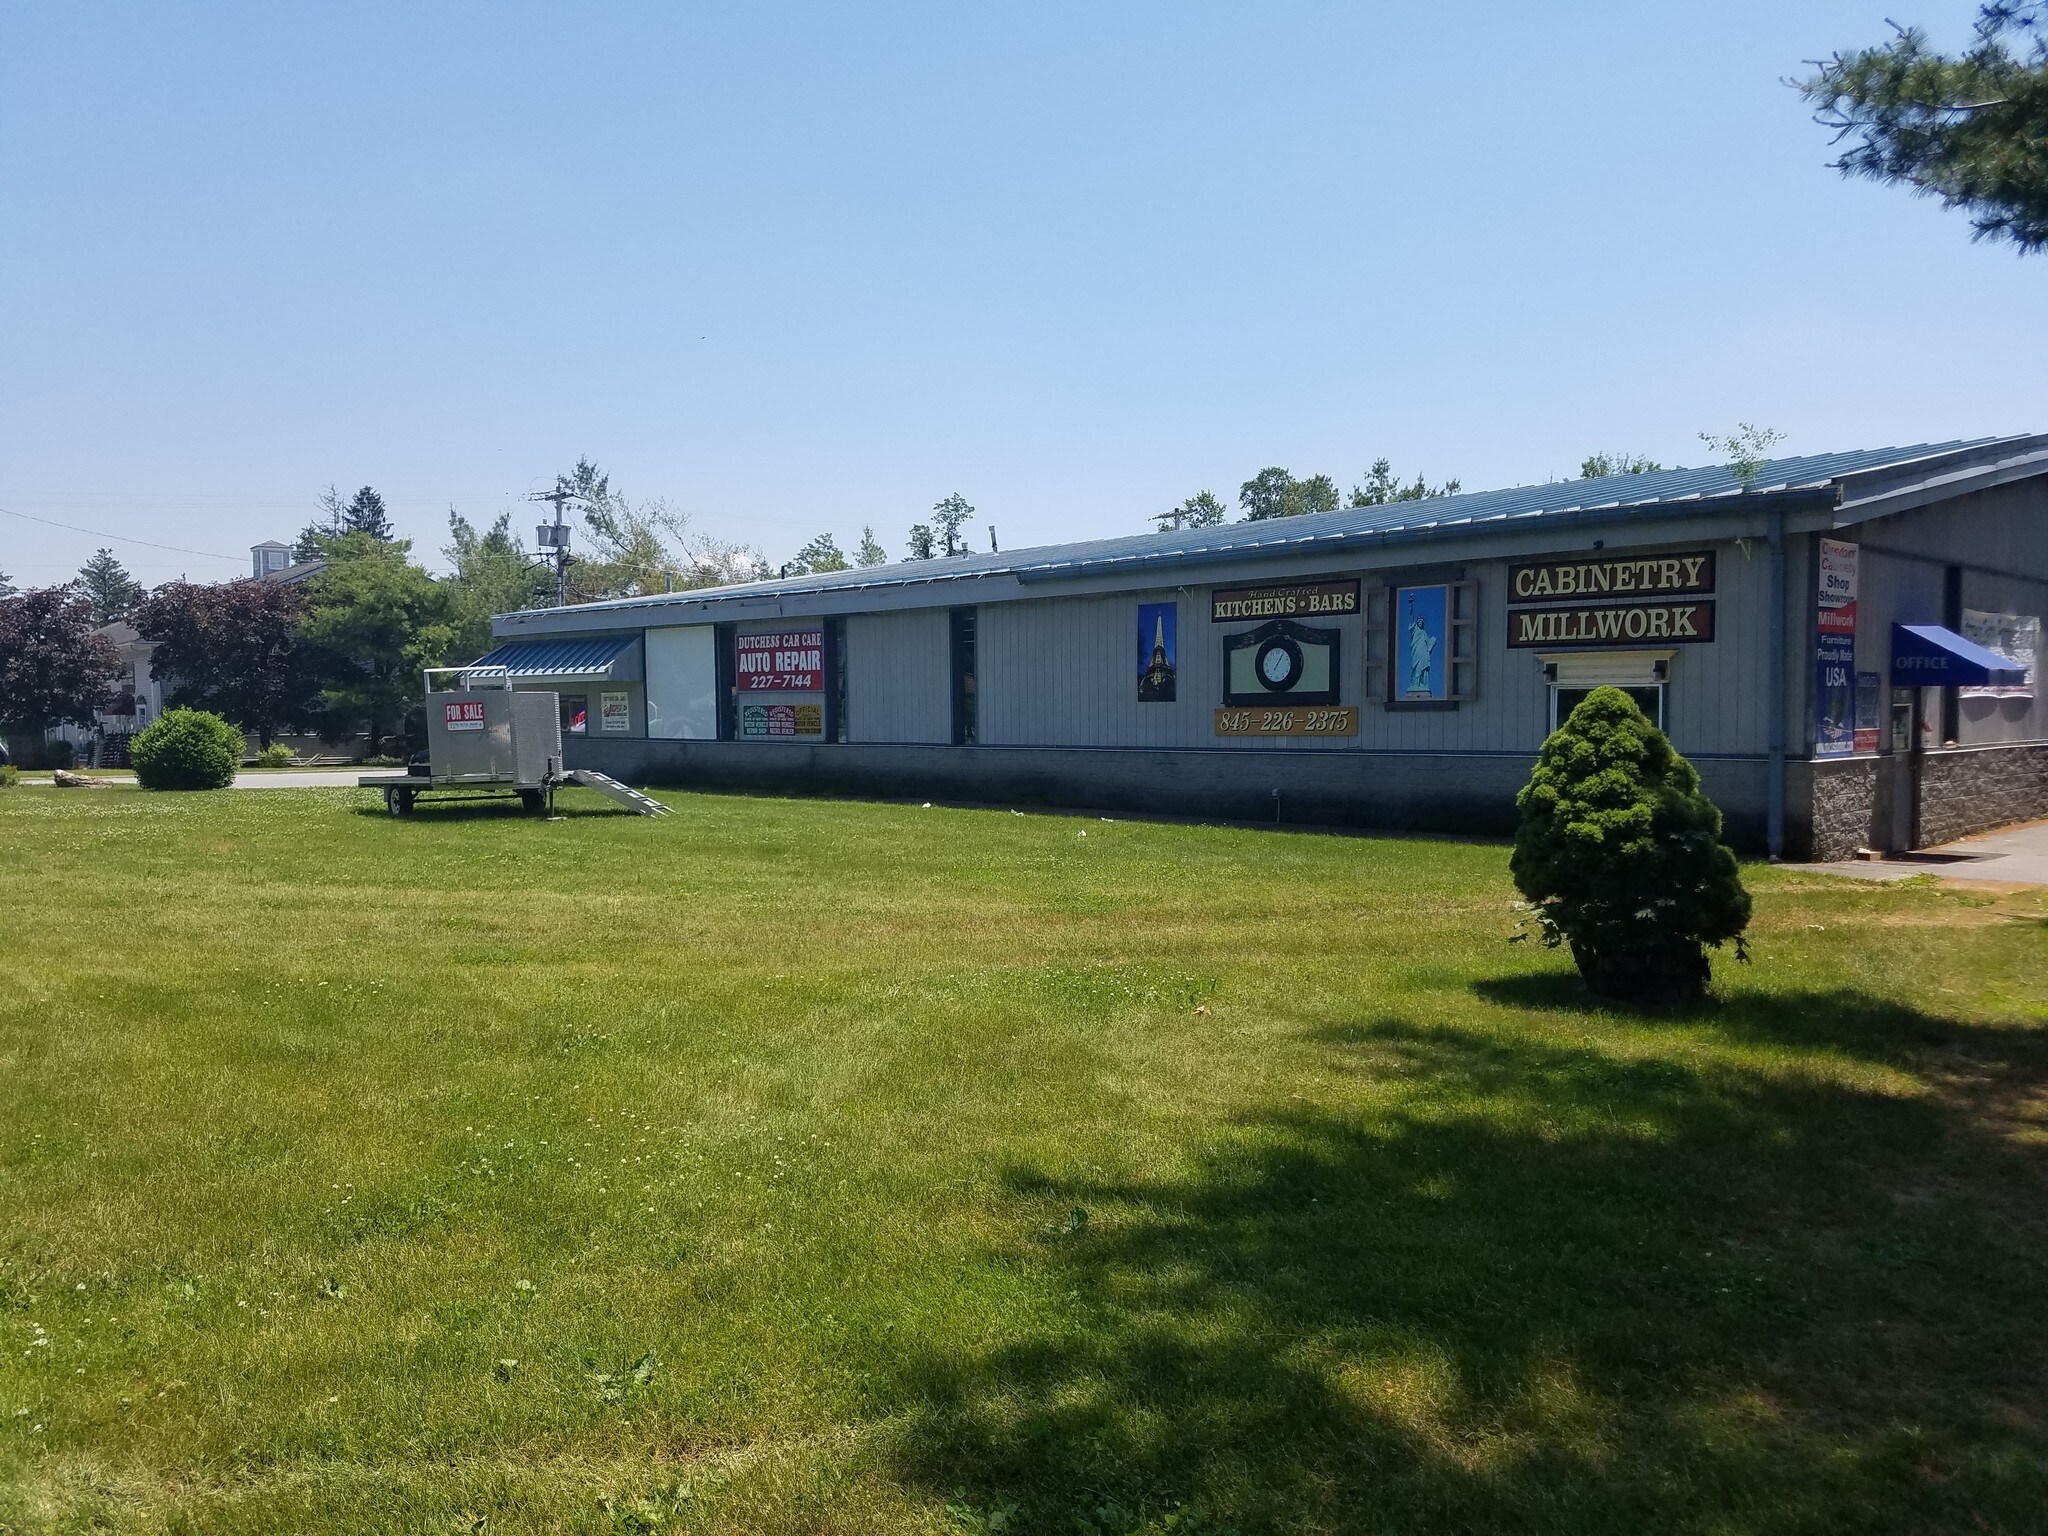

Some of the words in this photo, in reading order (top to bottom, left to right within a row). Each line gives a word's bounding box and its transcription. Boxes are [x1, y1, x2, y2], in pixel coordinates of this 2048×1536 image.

[1516, 557, 1705, 597] CABINETRY
[1827, 575, 1849, 593] Shop
[1249, 589, 1275, 598] Hand
[1278, 587, 1319, 596] Crafted
[1215, 597, 1296, 618] KITCHENS
[1309, 593, 1355, 612] BARS
[1519, 607, 1697, 641] MILLWORK
[1818, 612, 1854, 627] Millwork
[738, 635, 780, 649] DUTCHESS
[783, 634, 800, 647] CAR
[802, 633, 822, 646] CARE
[1821, 635, 1852, 645] Furniture
[739, 652, 771, 673] AUTO
[775, 650, 820, 671] REPAIR
[1817, 648, 1839, 664] Proudly
[1896, 656, 1949, 669] OFFICE
[750, 674, 811, 688] 227-7144
[1826, 667, 1847, 687] USA
[446, 705, 461, 720] FOR
[464, 704, 483, 720] SALE
[1220, 710, 1349, 732] 845-226-2375
